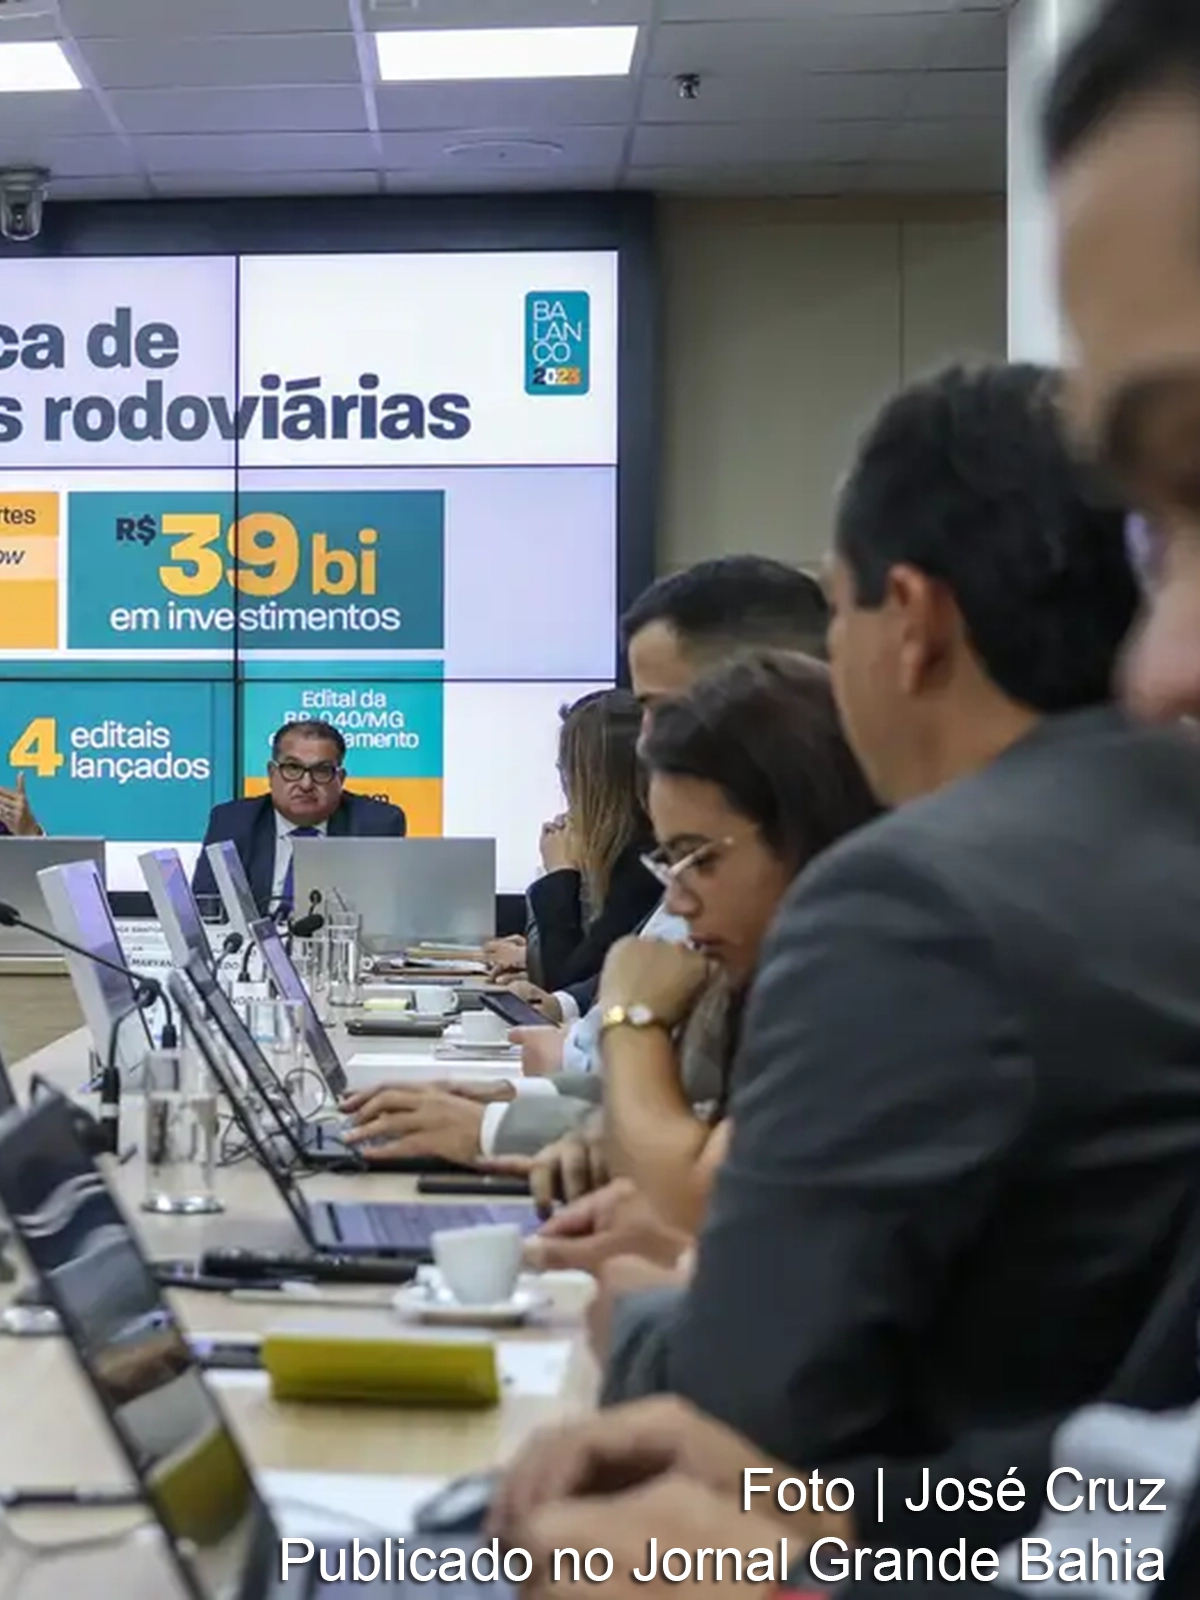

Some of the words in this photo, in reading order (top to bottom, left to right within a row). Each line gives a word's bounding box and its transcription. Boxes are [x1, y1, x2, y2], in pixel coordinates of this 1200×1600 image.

[533, 300, 567, 321] BA
[86, 306, 180, 369] de
[533, 321, 581, 341] LAN
[533, 367, 581, 385] 2023
[44, 373, 471, 443] rodoviárias
[115, 515, 157, 546] R$
[158, 511, 300, 597] 39
[311, 527, 378, 596] bi
[109, 607, 159, 631] em
[167, 601, 401, 632] investimentos
[301, 689, 357, 709] Edital
[359, 689, 387, 709] da
[70, 719, 171, 749] editais
[283, 710, 405, 729] BR040/MG
[8, 716, 65, 777] 4
[70, 751, 210, 785] lançados
